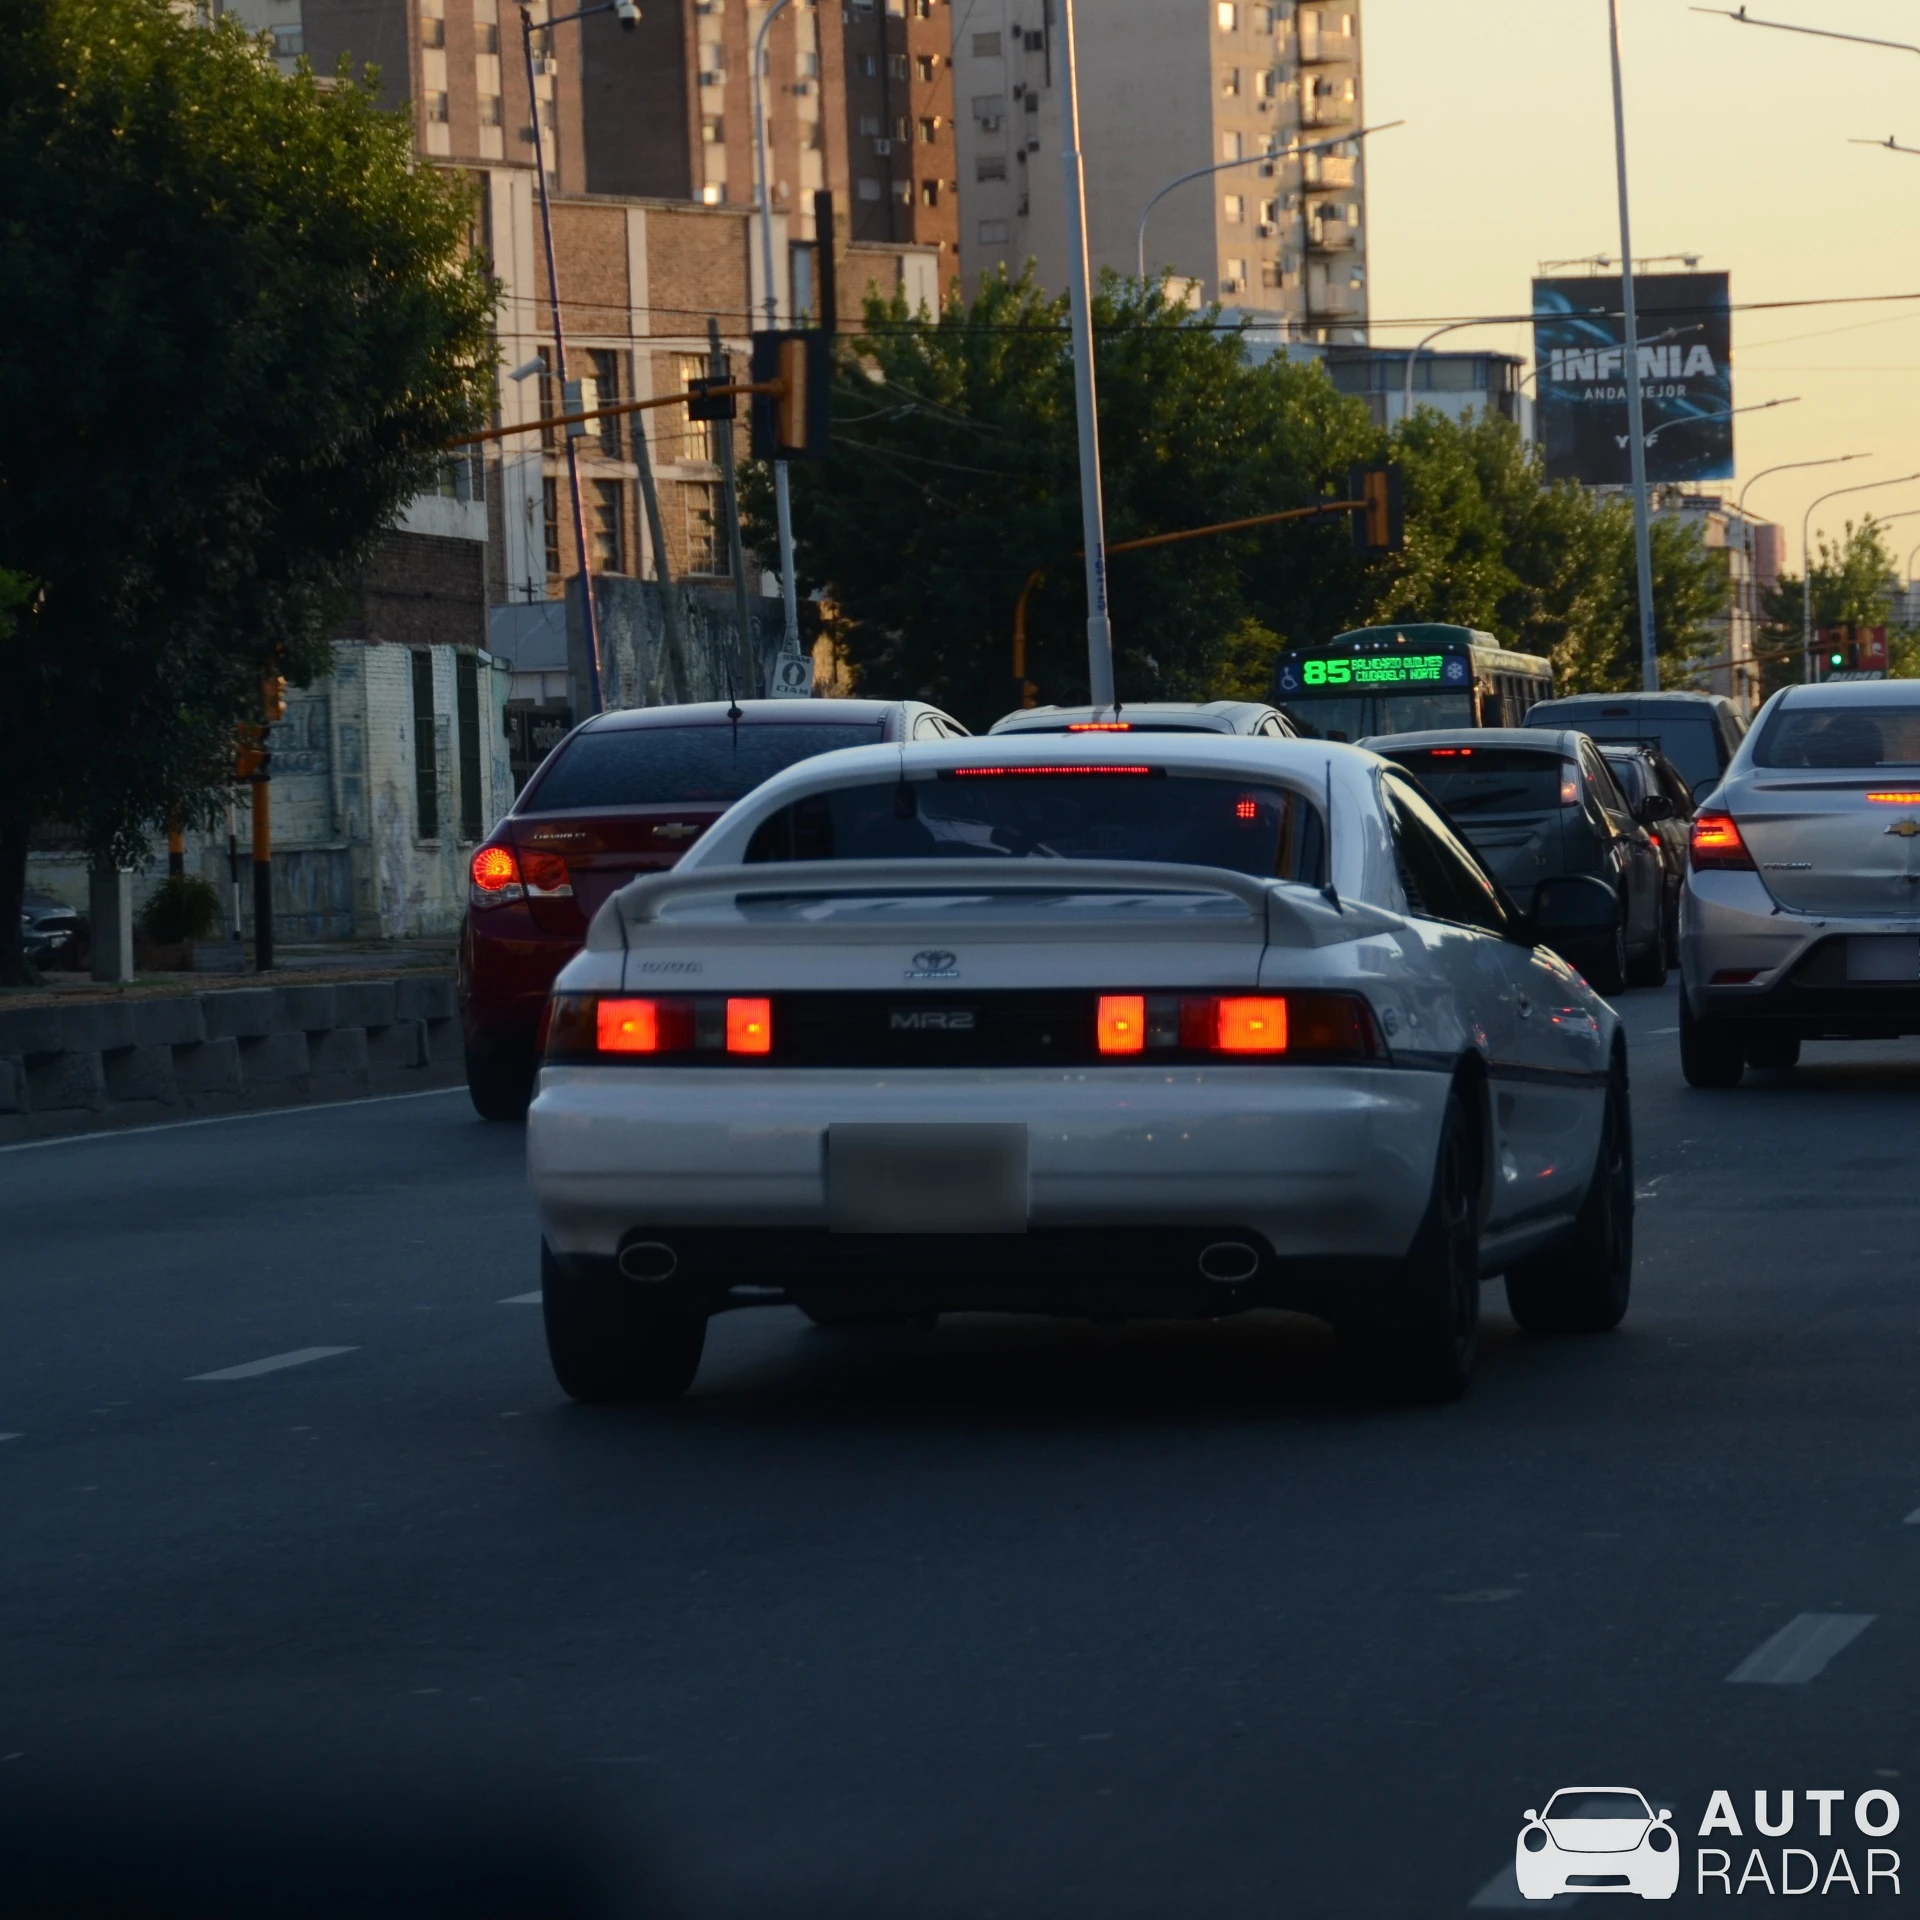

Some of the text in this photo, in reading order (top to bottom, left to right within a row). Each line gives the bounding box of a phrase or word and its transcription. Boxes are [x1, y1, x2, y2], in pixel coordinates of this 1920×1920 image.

[1551, 344, 1717, 381] INFNIA
[1615, 434, 1659, 449] YF
[1403, 655, 1443, 669] QUILMES
[1303, 659, 1351, 685] 85
[1355, 668, 1441, 682] CIUDADELA NORTE
[890, 1011, 975, 1030] MR2
